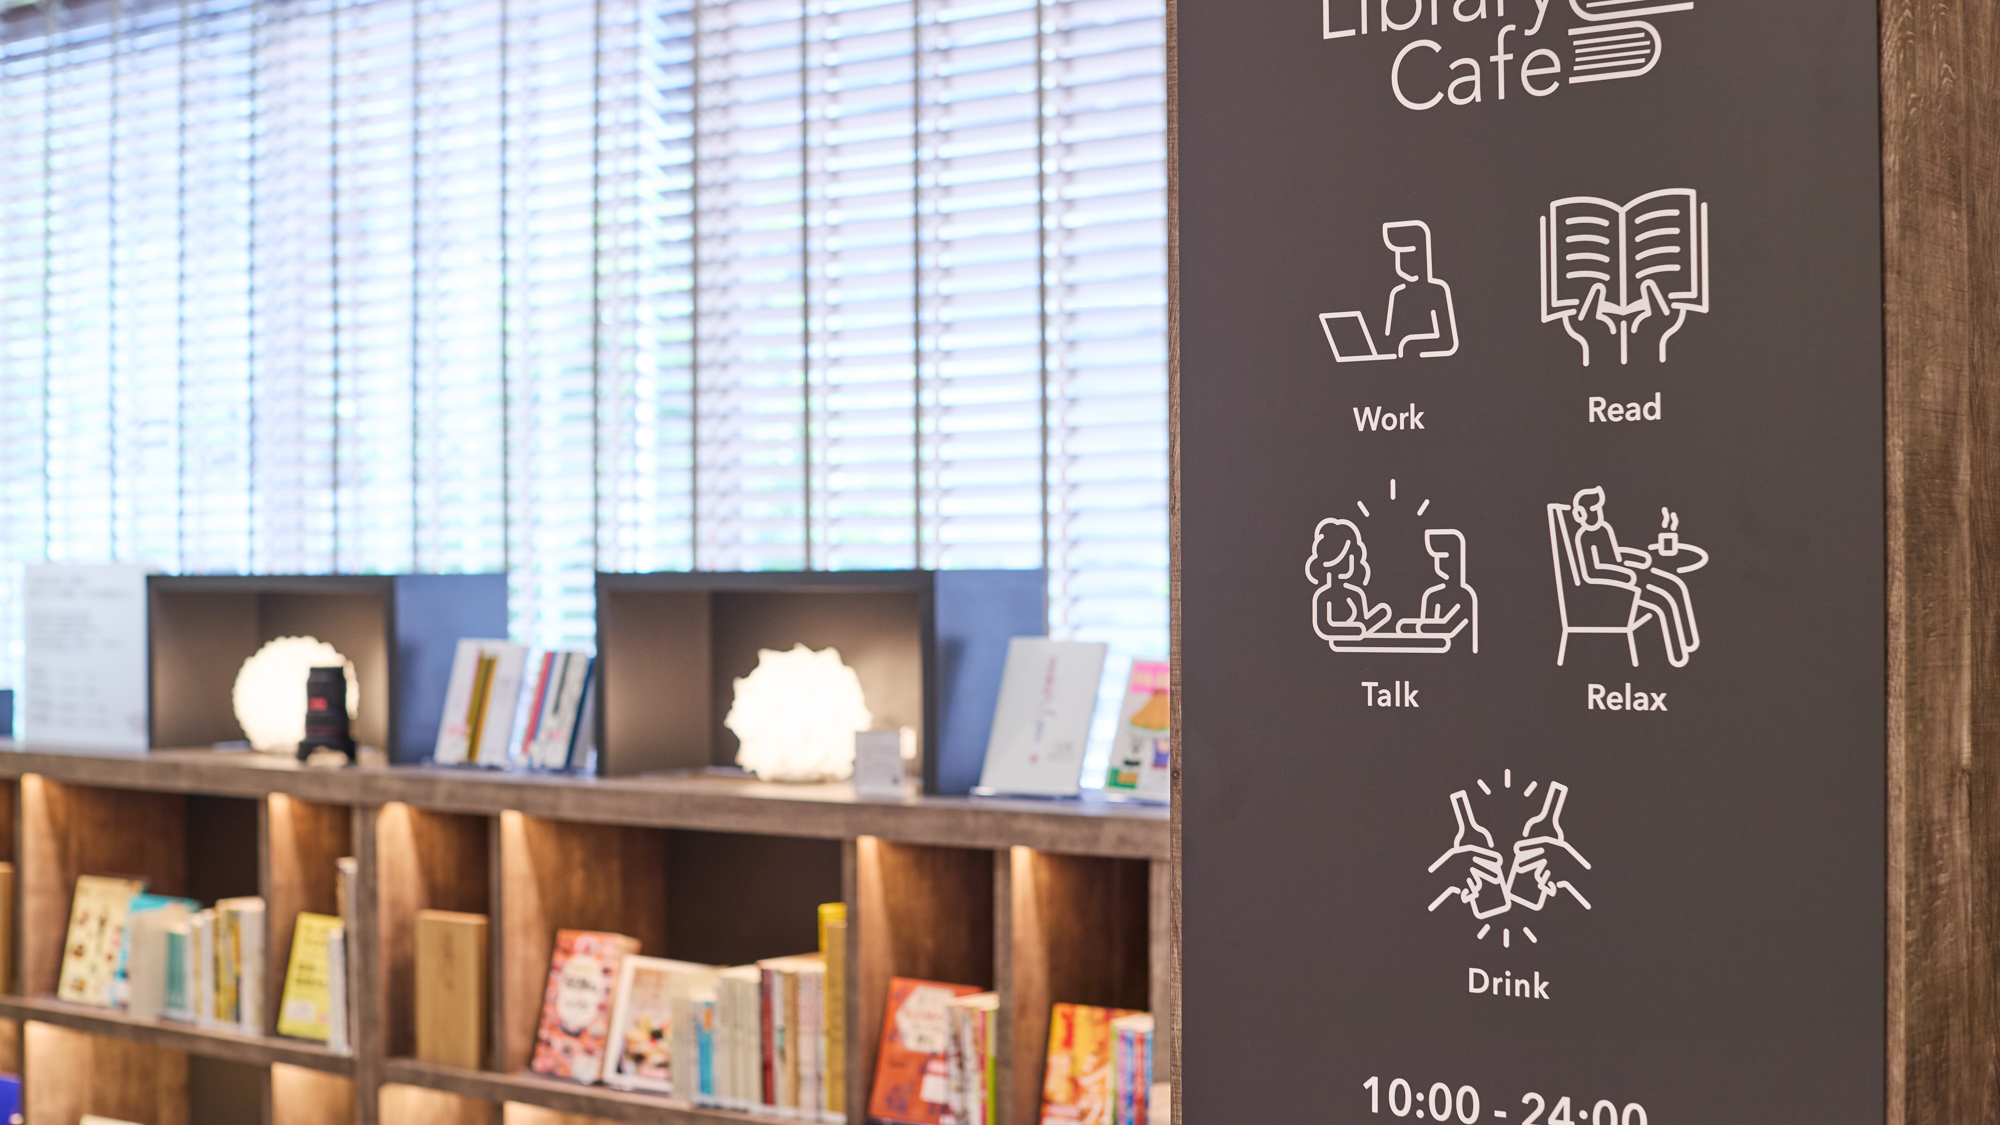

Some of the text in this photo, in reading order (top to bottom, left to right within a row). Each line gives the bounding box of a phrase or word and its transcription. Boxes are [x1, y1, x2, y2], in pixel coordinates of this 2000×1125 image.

[1391, 24, 1561, 111] Cafe
[1352, 402, 1425, 432] Work
[1588, 391, 1662, 423] Read
[1361, 680, 1420, 708] Talk
[1587, 682, 1668, 712] Relax
[1468, 967, 1550, 1000] Drink
[1362, 1075, 1480, 1125] 10:00
[1521, 1091, 1649, 1125] 24:00
